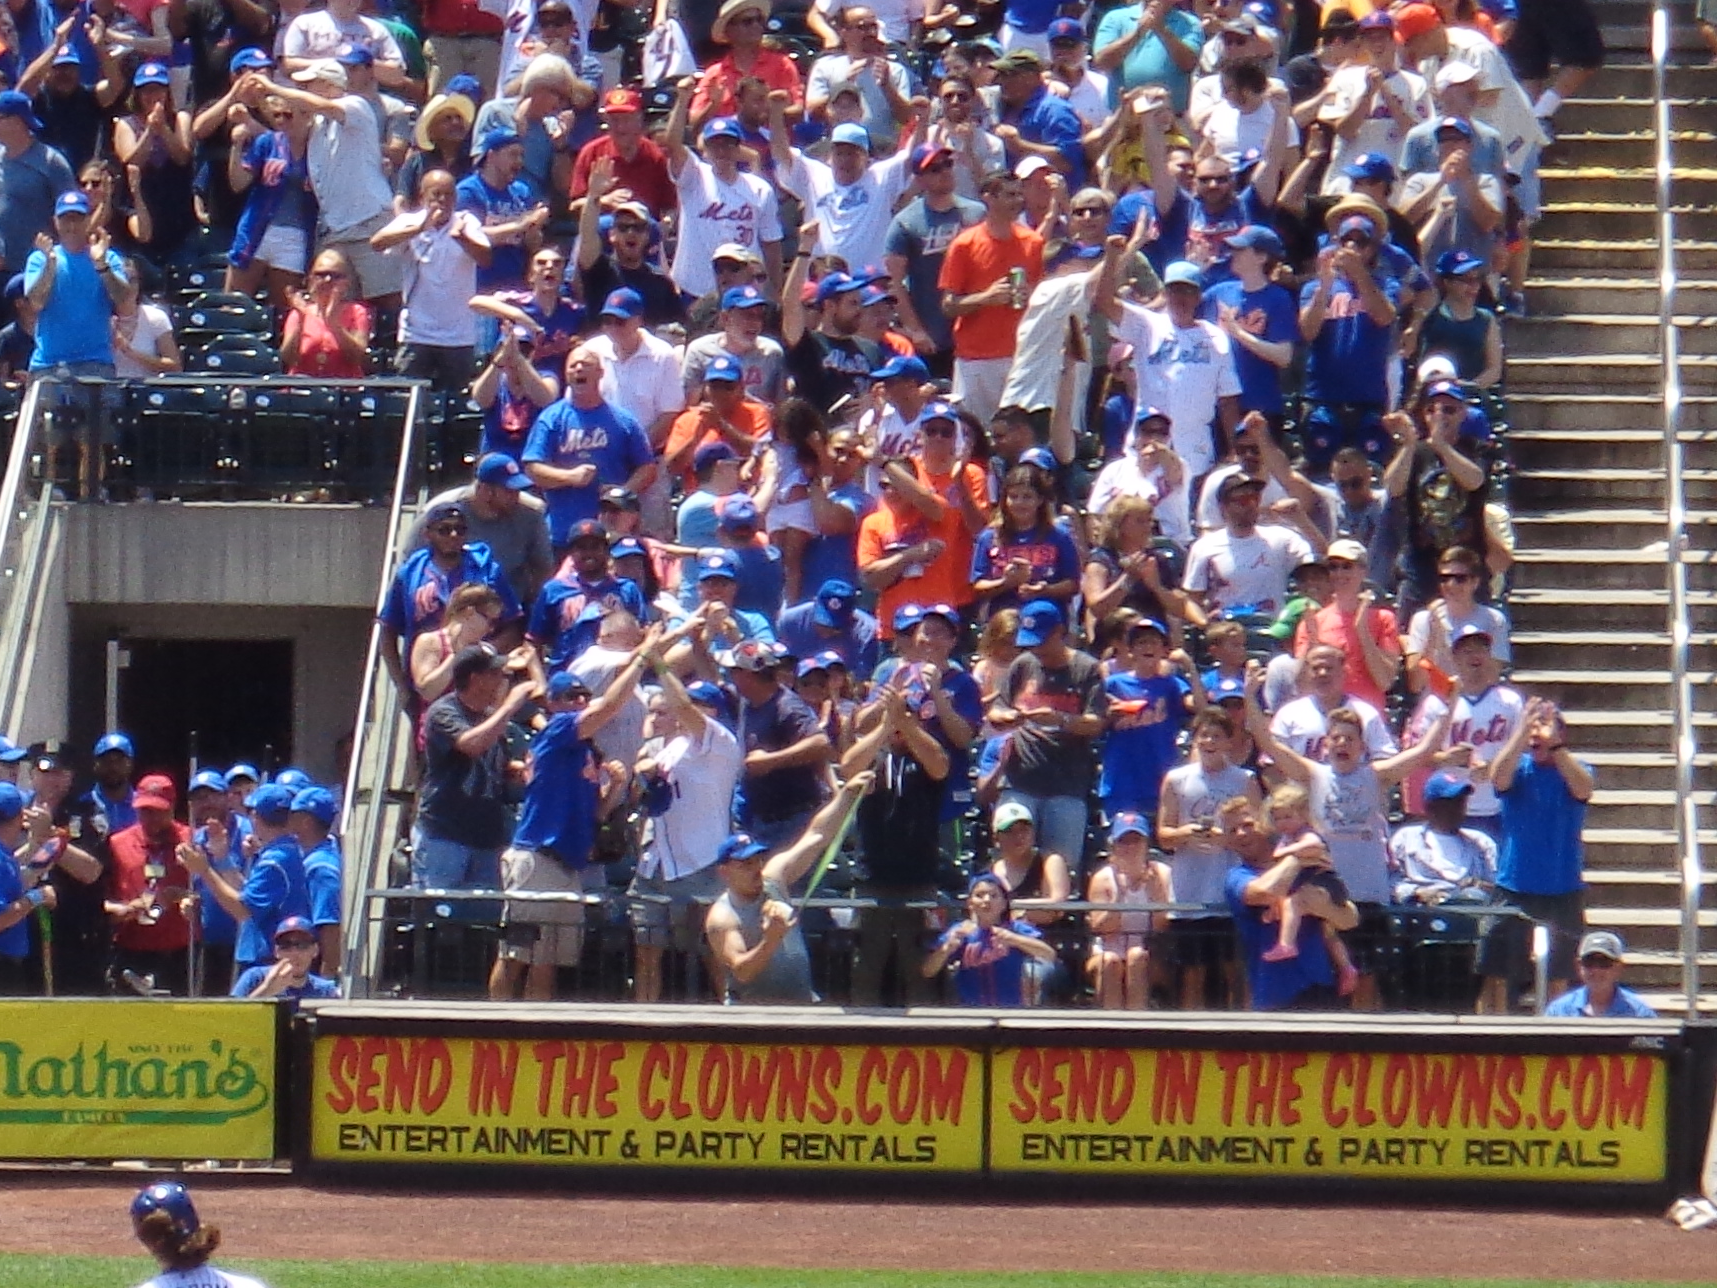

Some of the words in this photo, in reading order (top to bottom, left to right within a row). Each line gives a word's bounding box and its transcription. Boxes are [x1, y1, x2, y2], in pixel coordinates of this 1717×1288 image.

[700, 202, 752, 223] Mets
[562, 429, 607, 454] Mets
[1450, 716, 1509, 745] Mets
[325, 1036, 453, 1115] SEND
[466, 1039, 519, 1117] IN
[531, 1041, 627, 1120] THE
[637, 1043, 968, 1127] CLOWNS.COM
[1009, 1048, 1136, 1124] SEND
[1152, 1050, 1203, 1126] IN
[1217, 1051, 1309, 1127] THE
[1321, 1053, 1655, 1132] CLOWNS.COM
[338, 1123, 609, 1159] ENTERTAINMENT
[620, 1129, 641, 1159] &
[654, 1130, 767, 1161] PARTY
[779, 1133, 938, 1163] RENTALS
[1021, 1133, 1295, 1165] ENTERTAINMENT
[1305, 1136, 1323, 1166] &
[1339, 1137, 1450, 1166] PARTY
[1464, 1139, 1621, 1168] RENTALS
